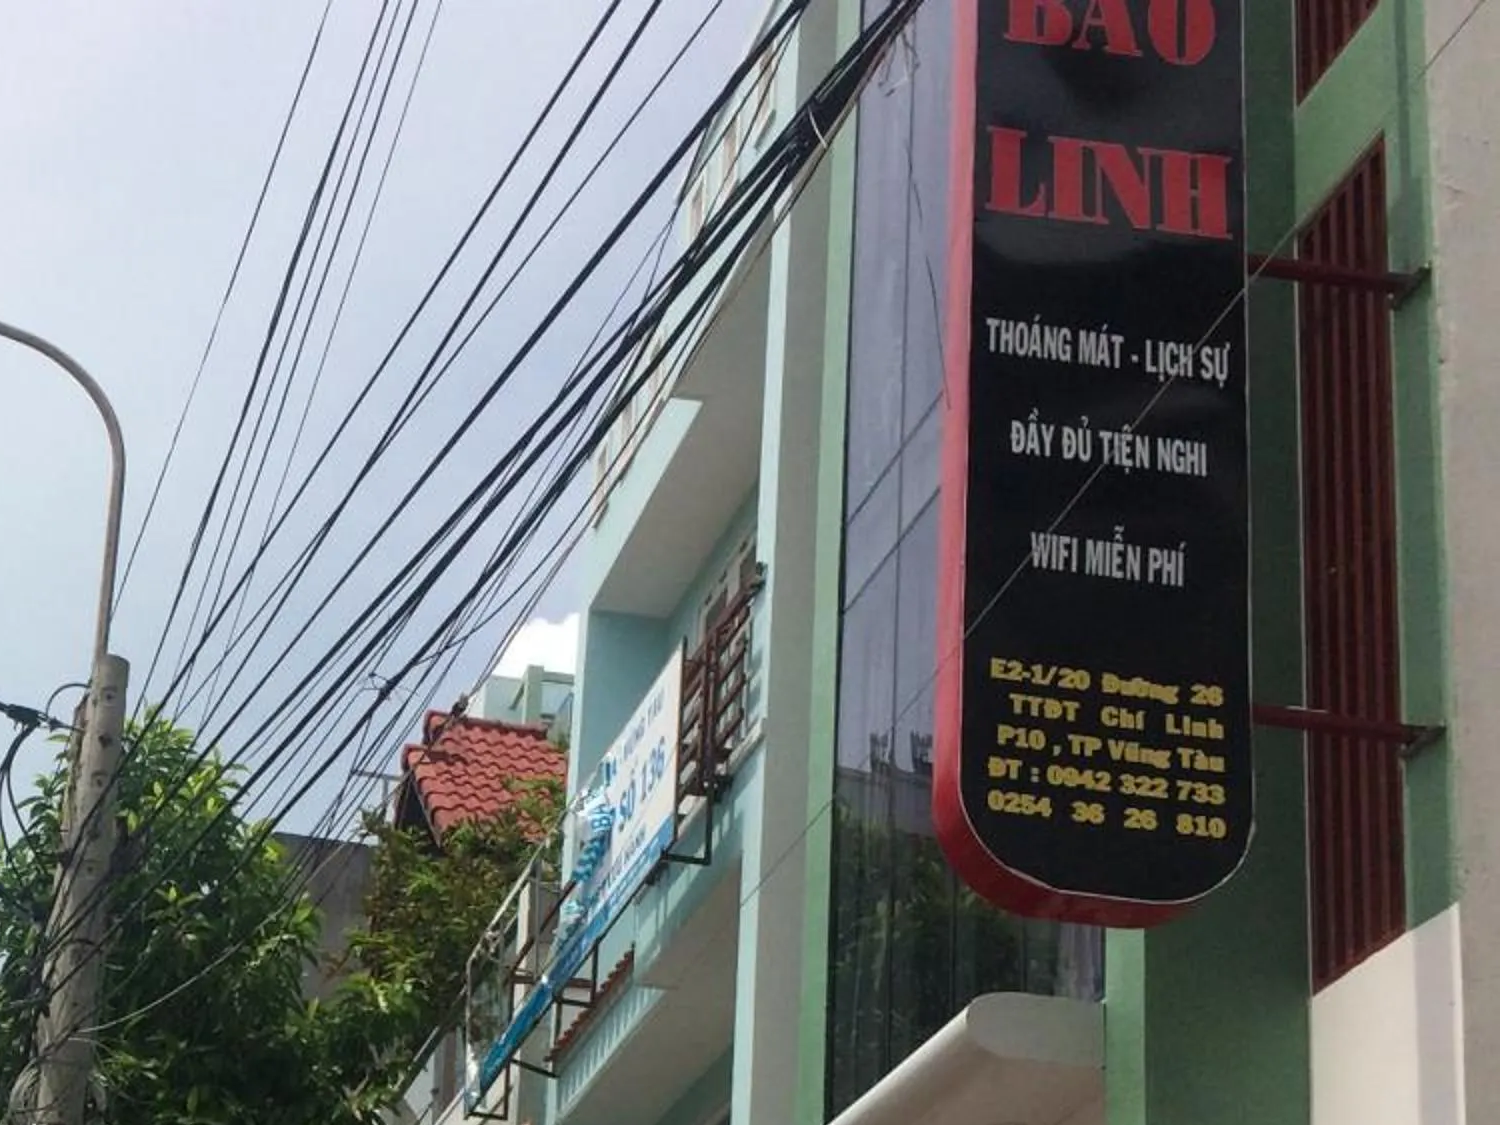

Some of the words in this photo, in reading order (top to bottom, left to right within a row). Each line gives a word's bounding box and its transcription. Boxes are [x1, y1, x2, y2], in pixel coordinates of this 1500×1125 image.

[985, 125, 1233, 240] LINH
[986, 314, 1072, 363] THOÁNG
[1078, 324, 1124, 369] MÁT
[1145, 339, 1193, 382] LỊCH
[1200, 342, 1232, 389] SỰ
[1061, 415, 1092, 462] ĐỦ
[1099, 424, 1150, 474] TIỆN
[1157, 437, 1208, 477] NGHI
[1031, 531, 1078, 573] WIFI
[1085, 525, 1141, 581] MIỄN
[1148, 541, 1187, 587] PHÍ
[1008, 693, 1080, 722] TTĐT
[1100, 705, 1146, 731] Chí
[1165, 713, 1224, 740] Linh
[996, 725, 1047, 750] P10
[1067, 734, 1102, 757] TP
[1108, 739, 1171, 770] Vũng
[1177, 747, 1226, 773] Tàu
[987, 756, 1023, 780] ĐT
[1118, 773, 1169, 800] 322
[987, 790, 1052, 818] 0254
